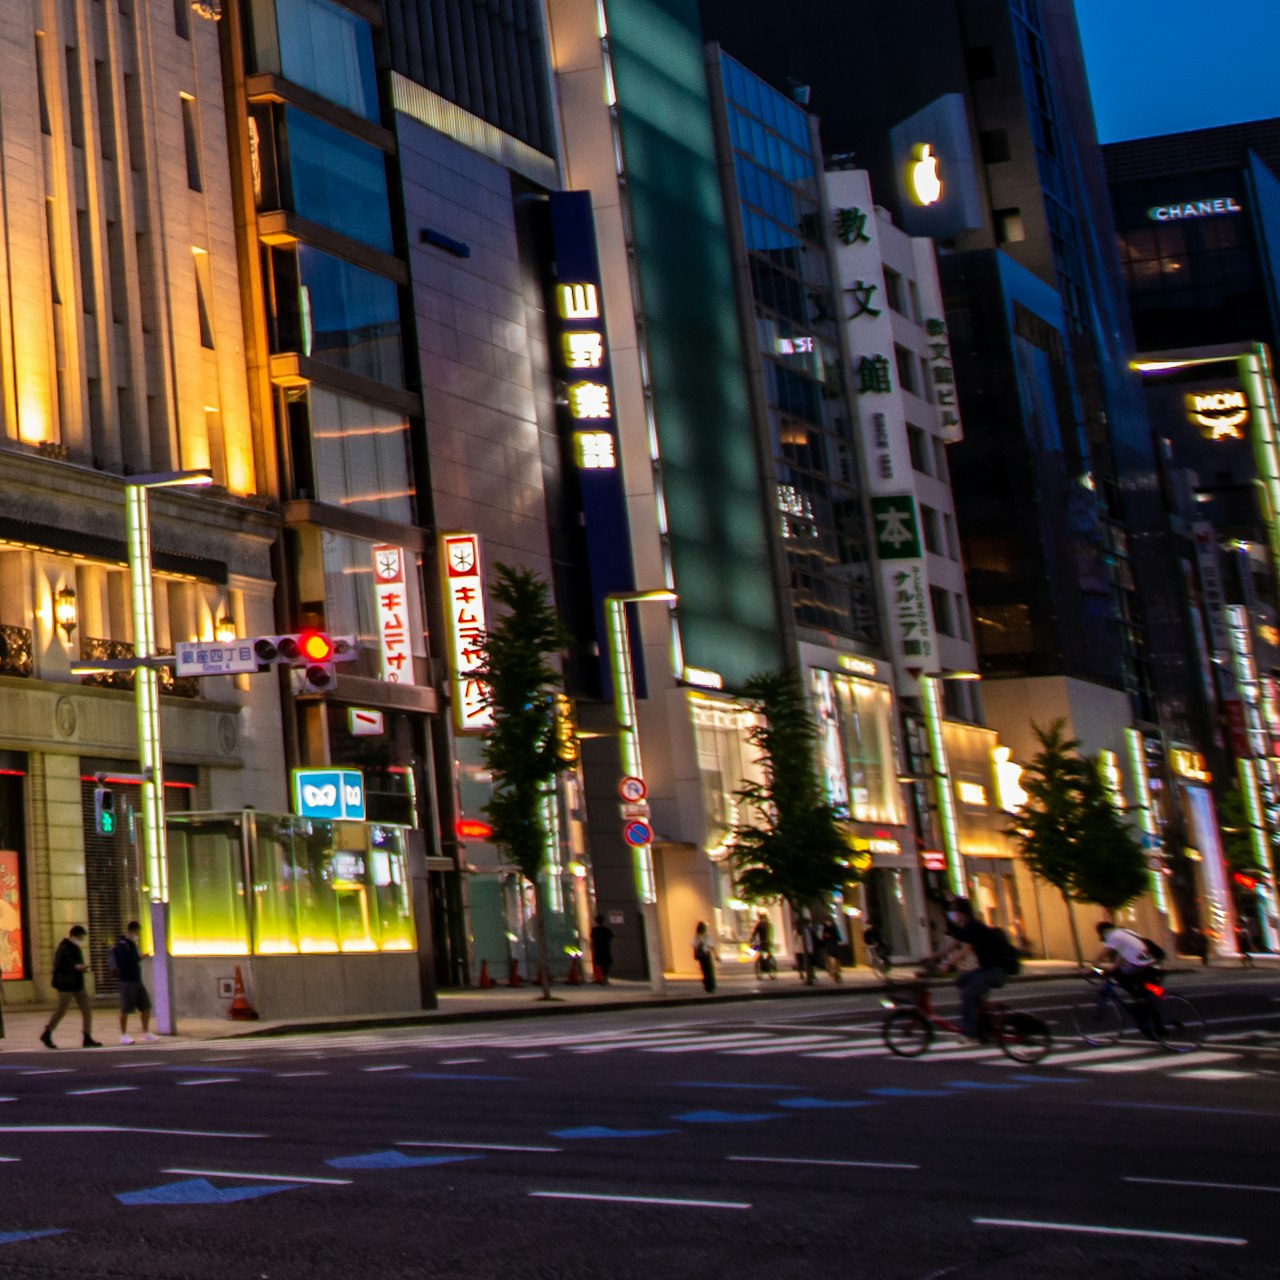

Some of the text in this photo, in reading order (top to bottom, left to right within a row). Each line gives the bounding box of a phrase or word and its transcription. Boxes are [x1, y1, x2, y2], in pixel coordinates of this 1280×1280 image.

[1152, 197, 1242, 220] CHANEL
[834, 206, 891, 394] 教文館
[1193, 391, 1246, 411] MCM
[876, 506, 913, 549] 本
[182, 646, 252, 664] 銀座四丁目
